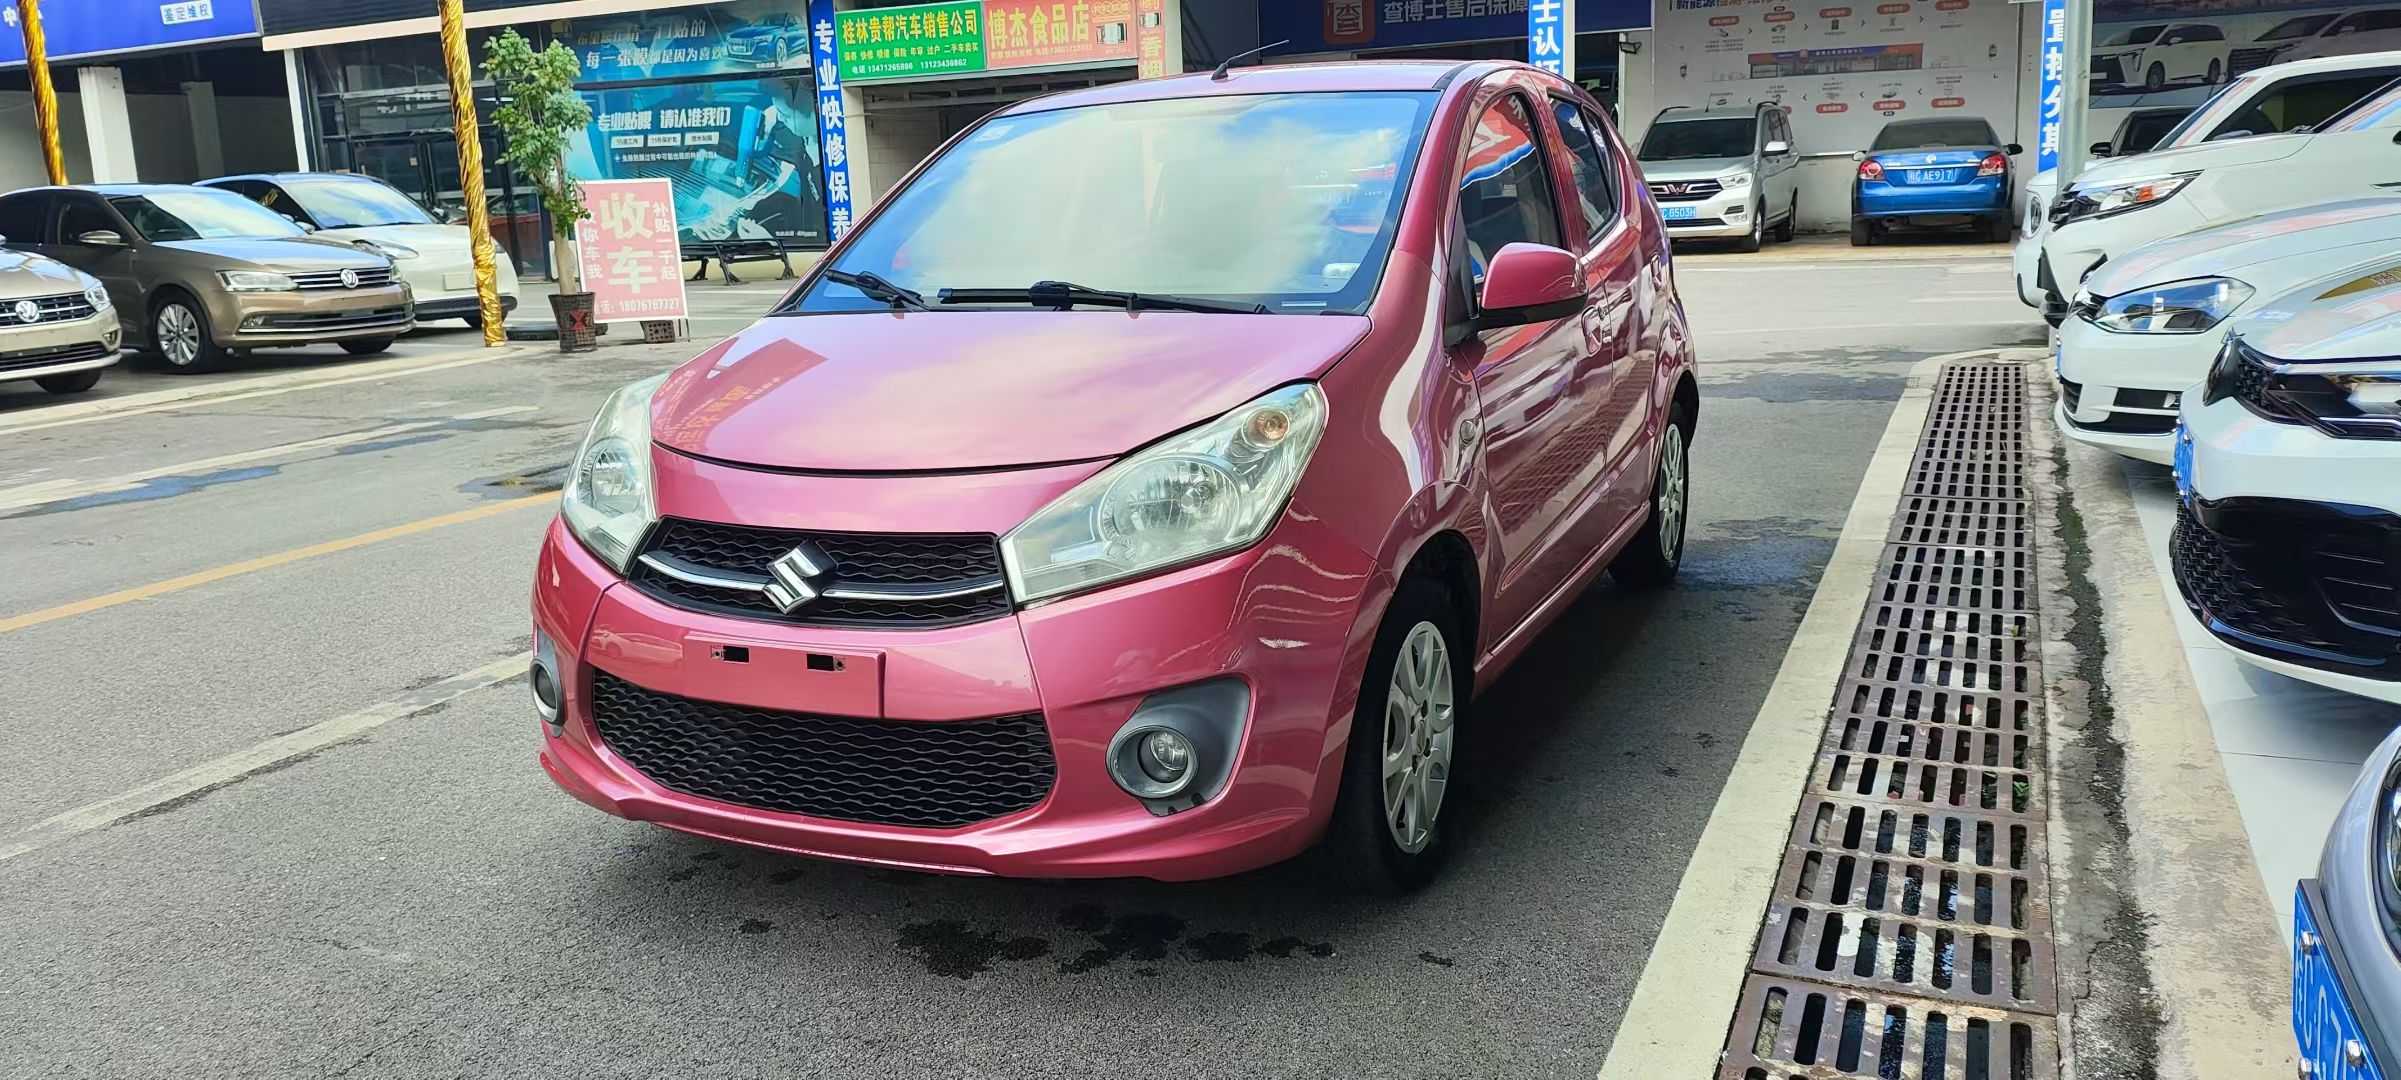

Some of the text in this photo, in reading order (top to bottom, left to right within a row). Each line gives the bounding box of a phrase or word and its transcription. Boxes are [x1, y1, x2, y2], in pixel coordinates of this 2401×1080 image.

[843, 9, 978, 45] 桂林贵帮汽车销售公司
[989, 0, 1090, 49] 博杰食品店
[660, 106, 731, 128] 请认准我们
[814, 18, 852, 241] 专业快修保养
